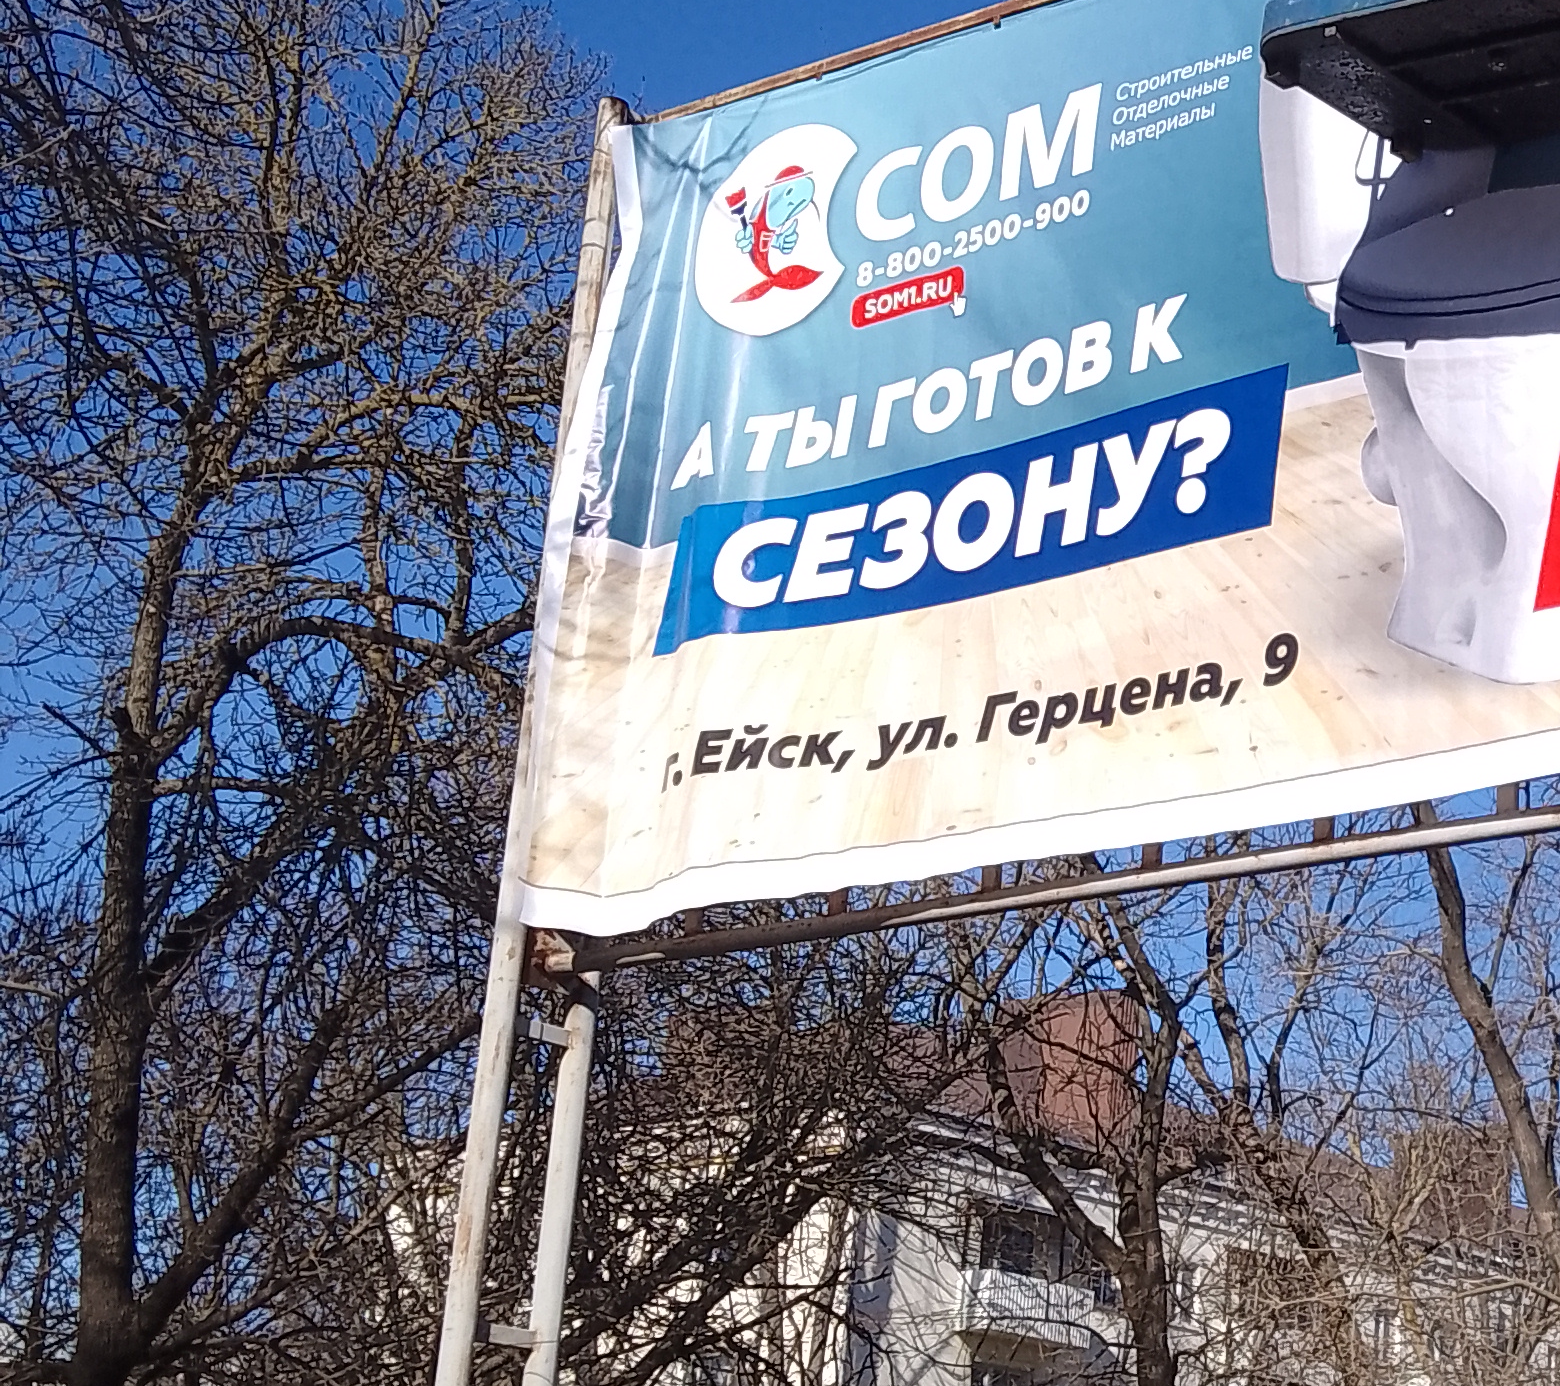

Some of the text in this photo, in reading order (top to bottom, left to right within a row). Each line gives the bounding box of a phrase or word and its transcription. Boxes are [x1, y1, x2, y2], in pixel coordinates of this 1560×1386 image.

[1112, 74, 1230, 125] Отделочные
[1116, 44, 1253, 101] Строительные
[855, 83, 1102, 241] СОМ
[1110, 103, 1216, 151] Материалы
[856, 189, 1090, 287] 8-800-2500-900
[864, 276, 953, 319] SOM1.RU
[670, 293, 1188, 490] А ТЫ ГОТОВ К
[712, 408, 1232, 608] СЕЗОНУ?
[867, 715, 959, 770] ул.
[976, 661, 1244, 744] Герцена,
[1263, 632, 1301, 687] 9
